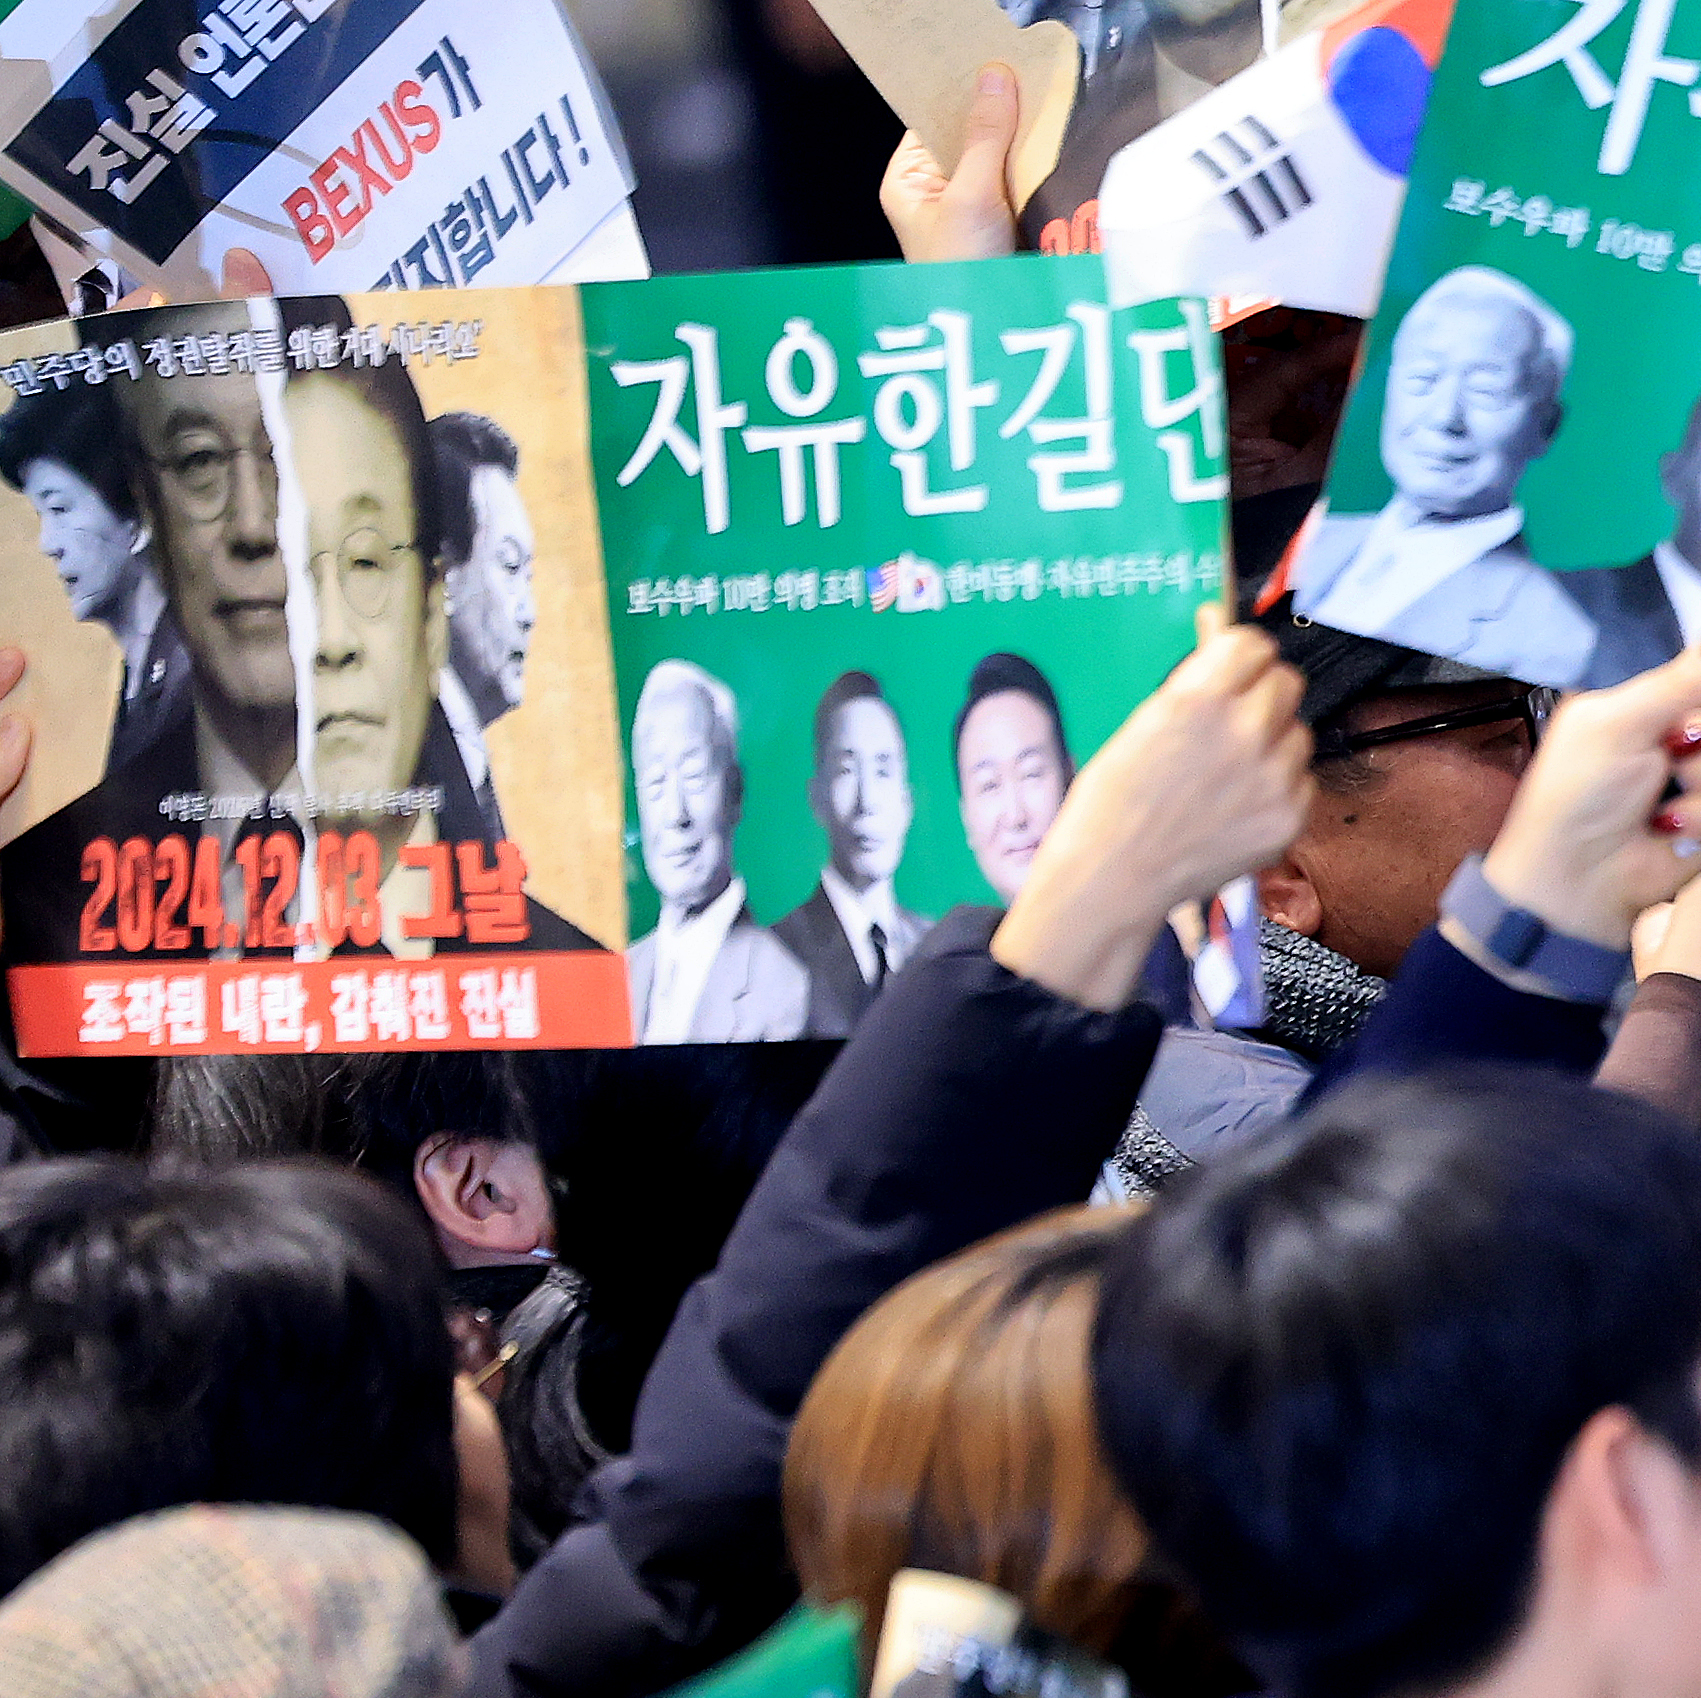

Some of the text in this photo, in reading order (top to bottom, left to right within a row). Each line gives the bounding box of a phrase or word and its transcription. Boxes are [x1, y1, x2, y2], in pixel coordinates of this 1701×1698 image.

[65, 0, 337, 205] 진실 언론
[280, 35, 485, 265] BEXUS가
[1442, 175, 1592, 249] 보수우파
[287, 321, 342, 371] 위한
[608, 300, 1229, 534] 자유한길단
[627, 570, 720, 618] 보수우파
[79, 829, 532, 951] 2024.12.03 그날
[79, 964, 541, 1052] 조작된 내란, 감춰진 진실
